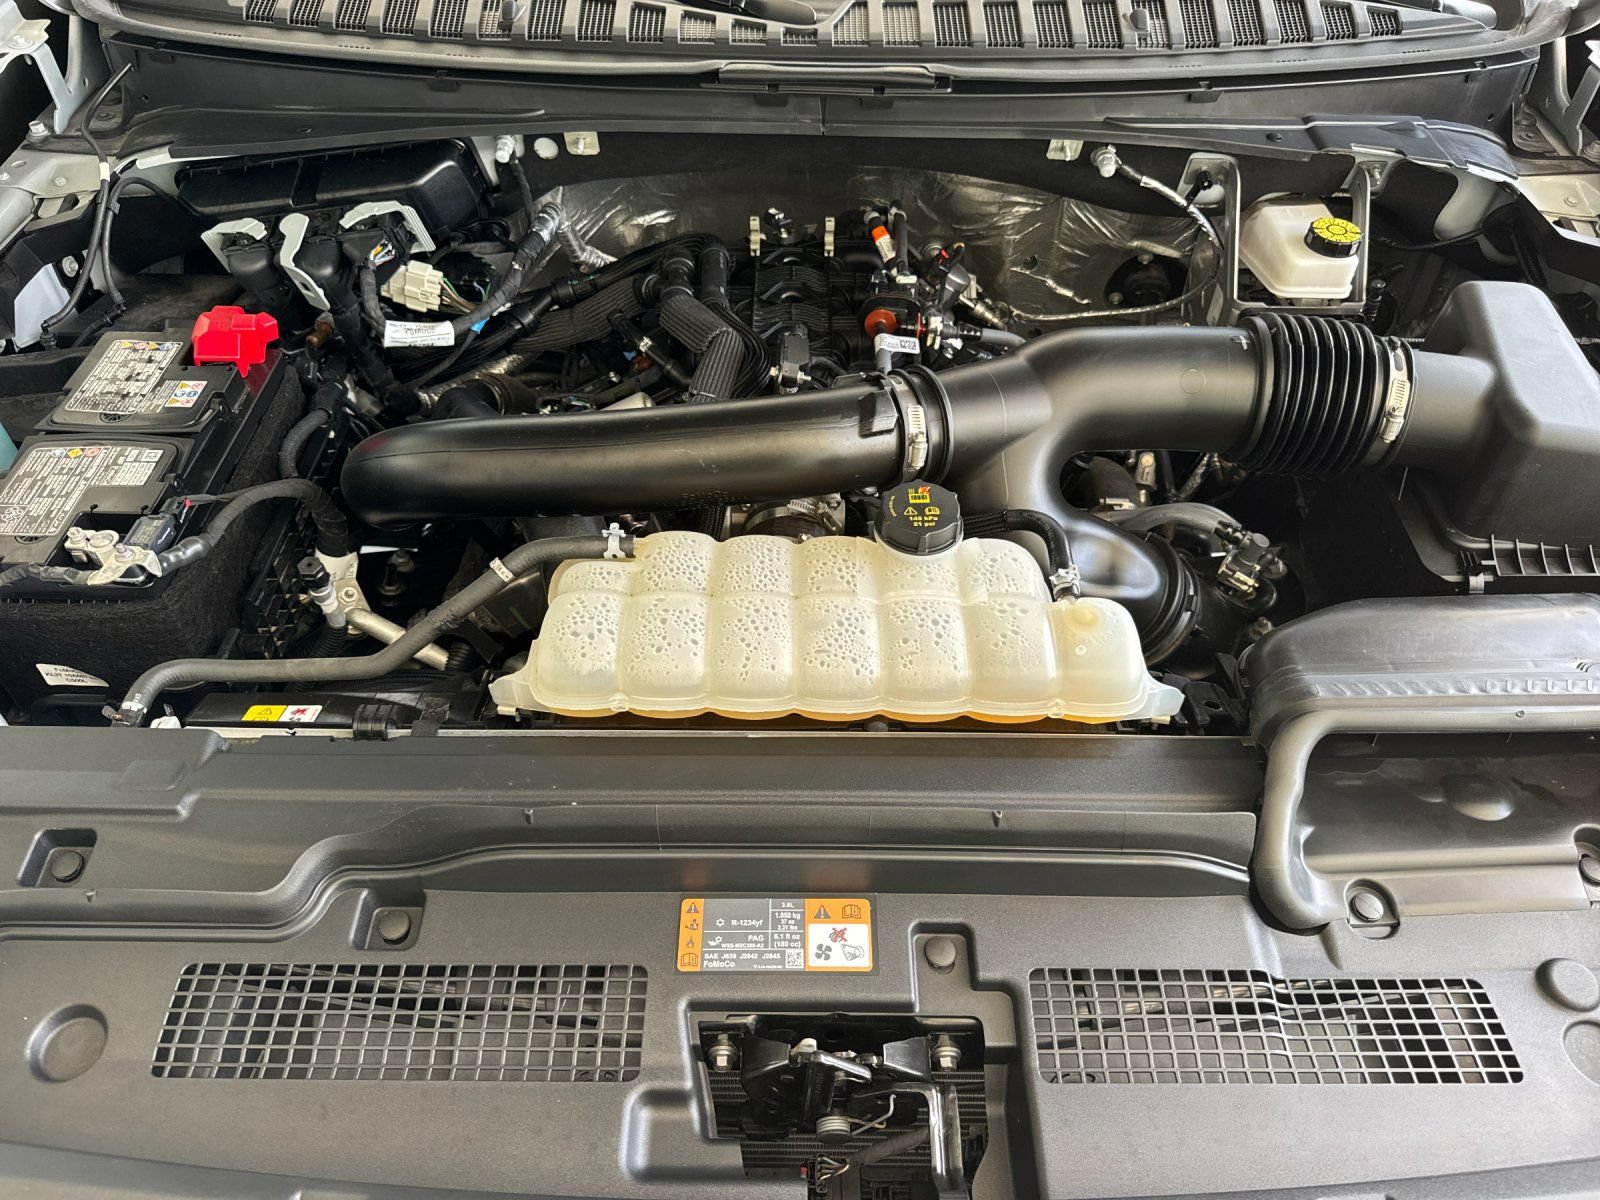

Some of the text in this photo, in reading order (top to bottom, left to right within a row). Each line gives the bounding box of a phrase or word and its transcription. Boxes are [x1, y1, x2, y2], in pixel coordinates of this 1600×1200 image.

[792, 912, 801, 920] kg
[731, 919, 764, 927] R-1234yf
[747, 934, 764, 942] PAG
[703, 960, 736, 968] FoMoCo
